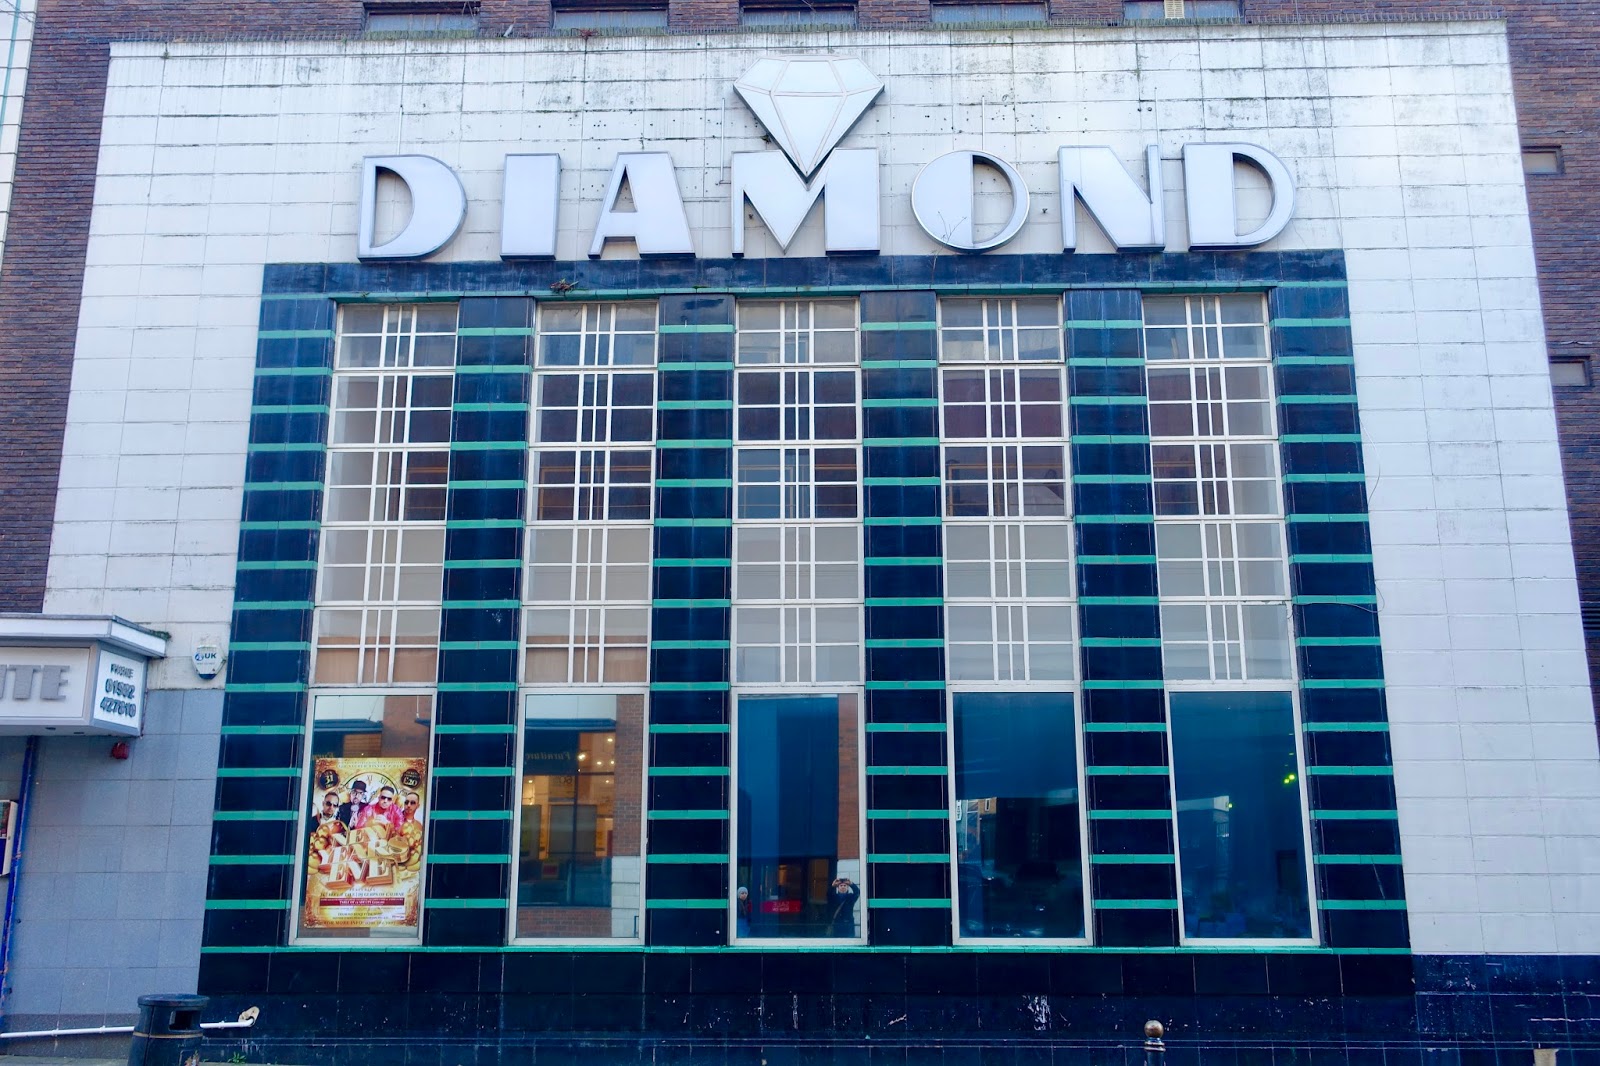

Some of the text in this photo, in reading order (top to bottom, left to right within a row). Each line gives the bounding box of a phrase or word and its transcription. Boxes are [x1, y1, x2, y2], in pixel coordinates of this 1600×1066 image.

[356, 142, 1297, 262] DIAMOND
[110, 663, 135, 679] PHONE
[326, 774, 336, 785] 31
[331, 823, 393, 847] NEW
[327, 859, 393, 889] EVE
